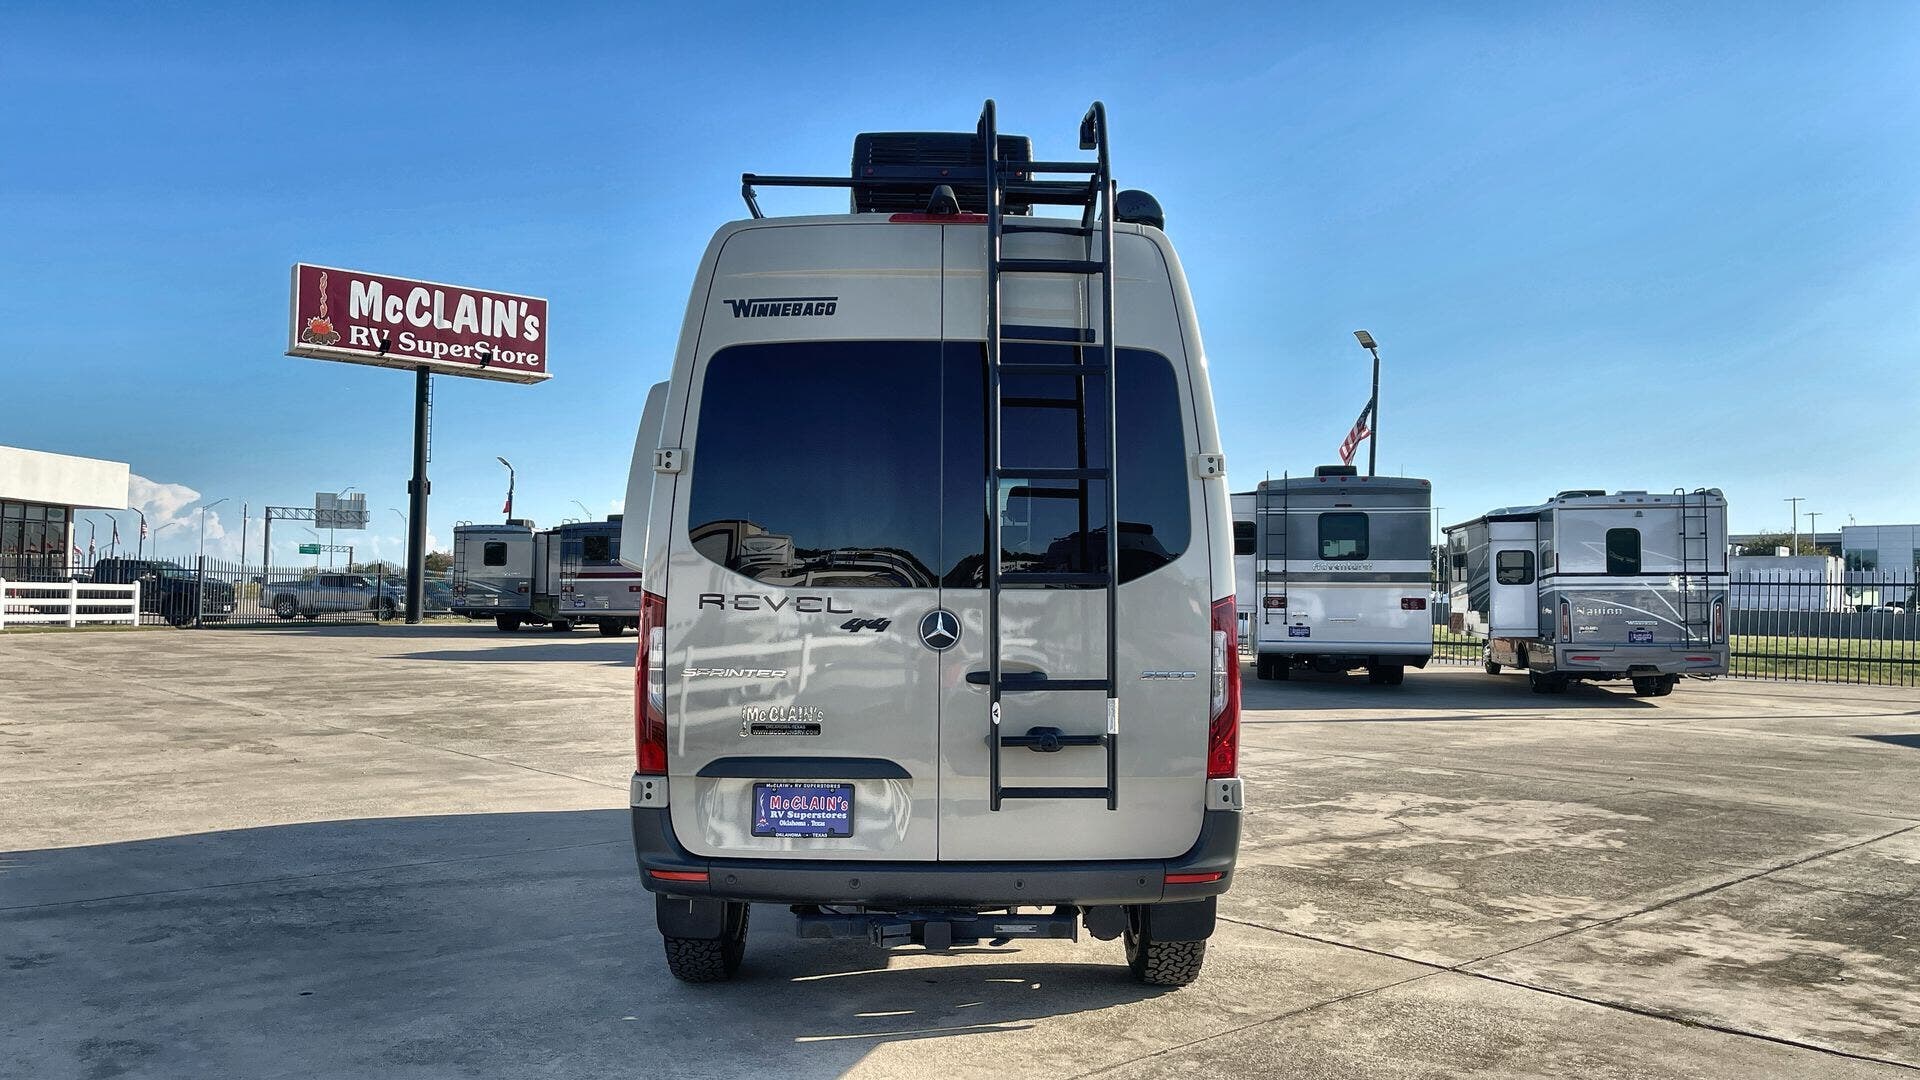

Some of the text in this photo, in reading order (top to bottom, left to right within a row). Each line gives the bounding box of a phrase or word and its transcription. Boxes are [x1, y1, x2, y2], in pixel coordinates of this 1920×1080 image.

[350, 279, 540, 342] McCLAIN's
[723, 297, 838, 318] WINNEBAGO
[349, 325, 539, 366] RV SuperStore
[698, 593, 853, 614] REVEL
[681, 668, 787, 679] SPRINTER
[769, 795, 848, 811] McCLAIN's
[787, 811, 847, 820] Superstores
